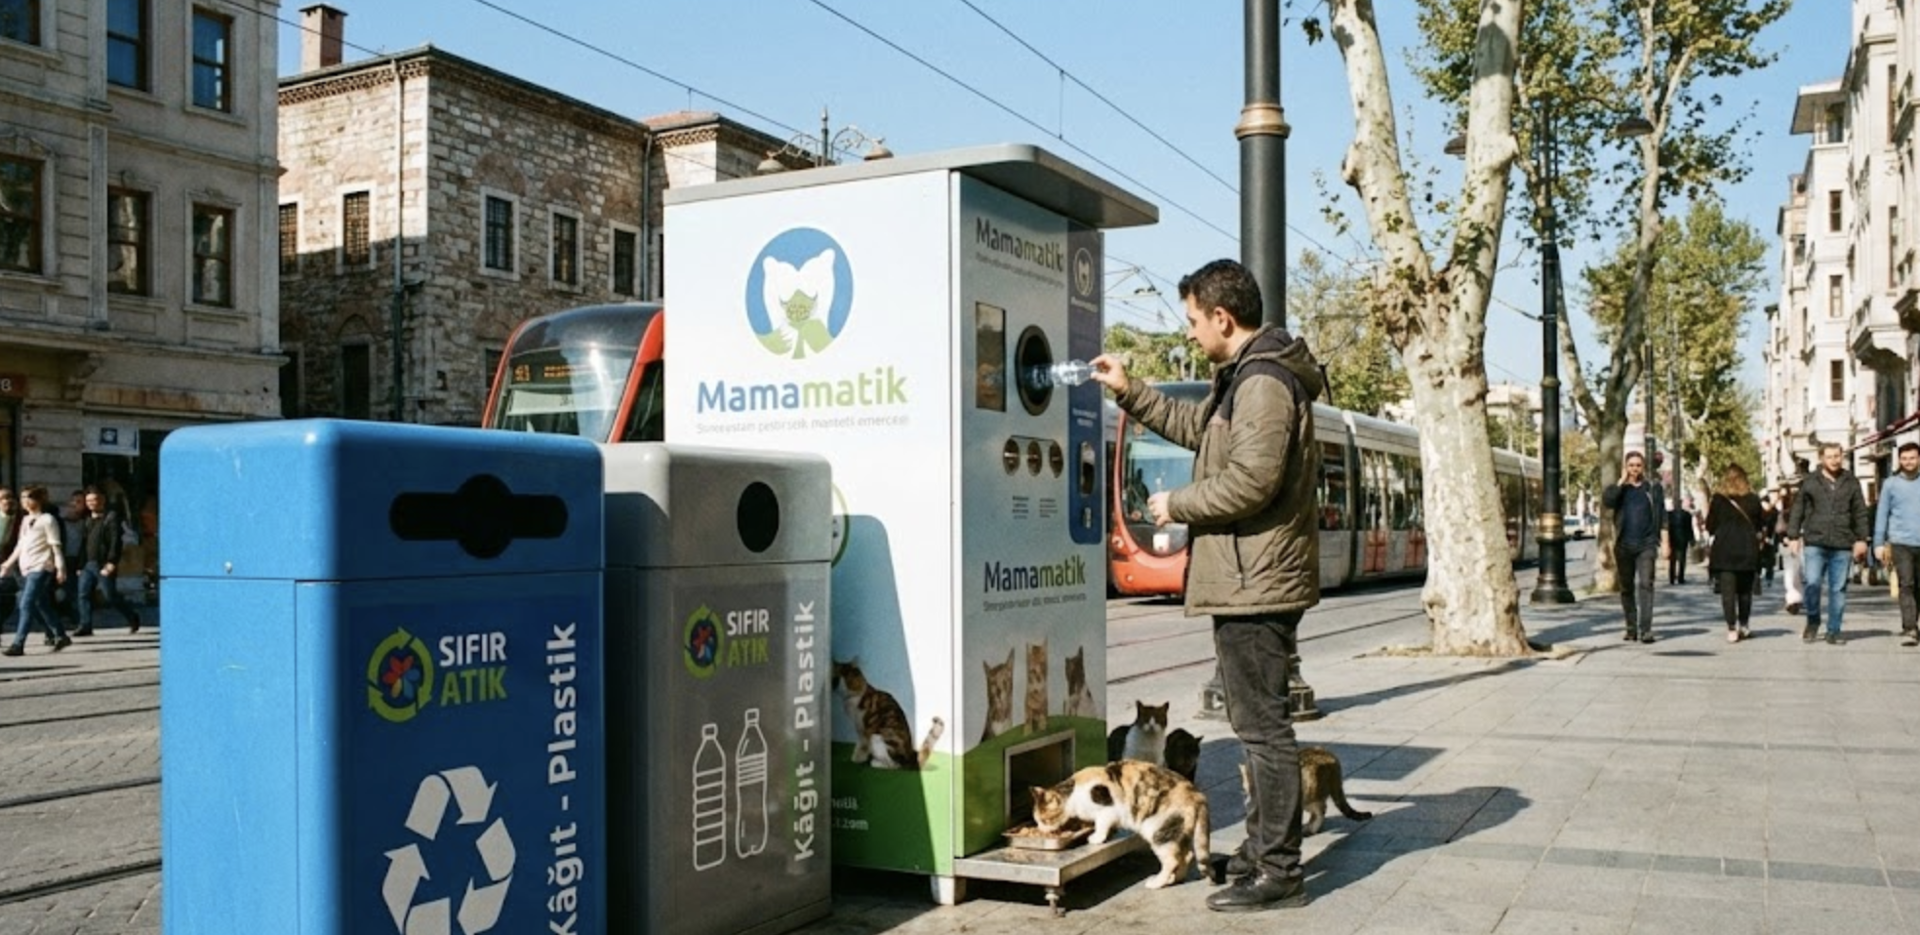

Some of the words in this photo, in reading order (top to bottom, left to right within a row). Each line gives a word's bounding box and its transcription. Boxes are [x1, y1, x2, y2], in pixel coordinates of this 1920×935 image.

[697, 366, 908, 413] Mamamatik
[983, 555, 1086, 593] Mamamatik
[727, 608, 770, 636] SIFIR
[439, 631, 507, 667] SIFIR
[793, 600, 815, 730] Plastik
[440, 665, 508, 707] ATIK
[547, 622, 577, 785] Plastik
[547, 822, 584, 935] Kâğıt
